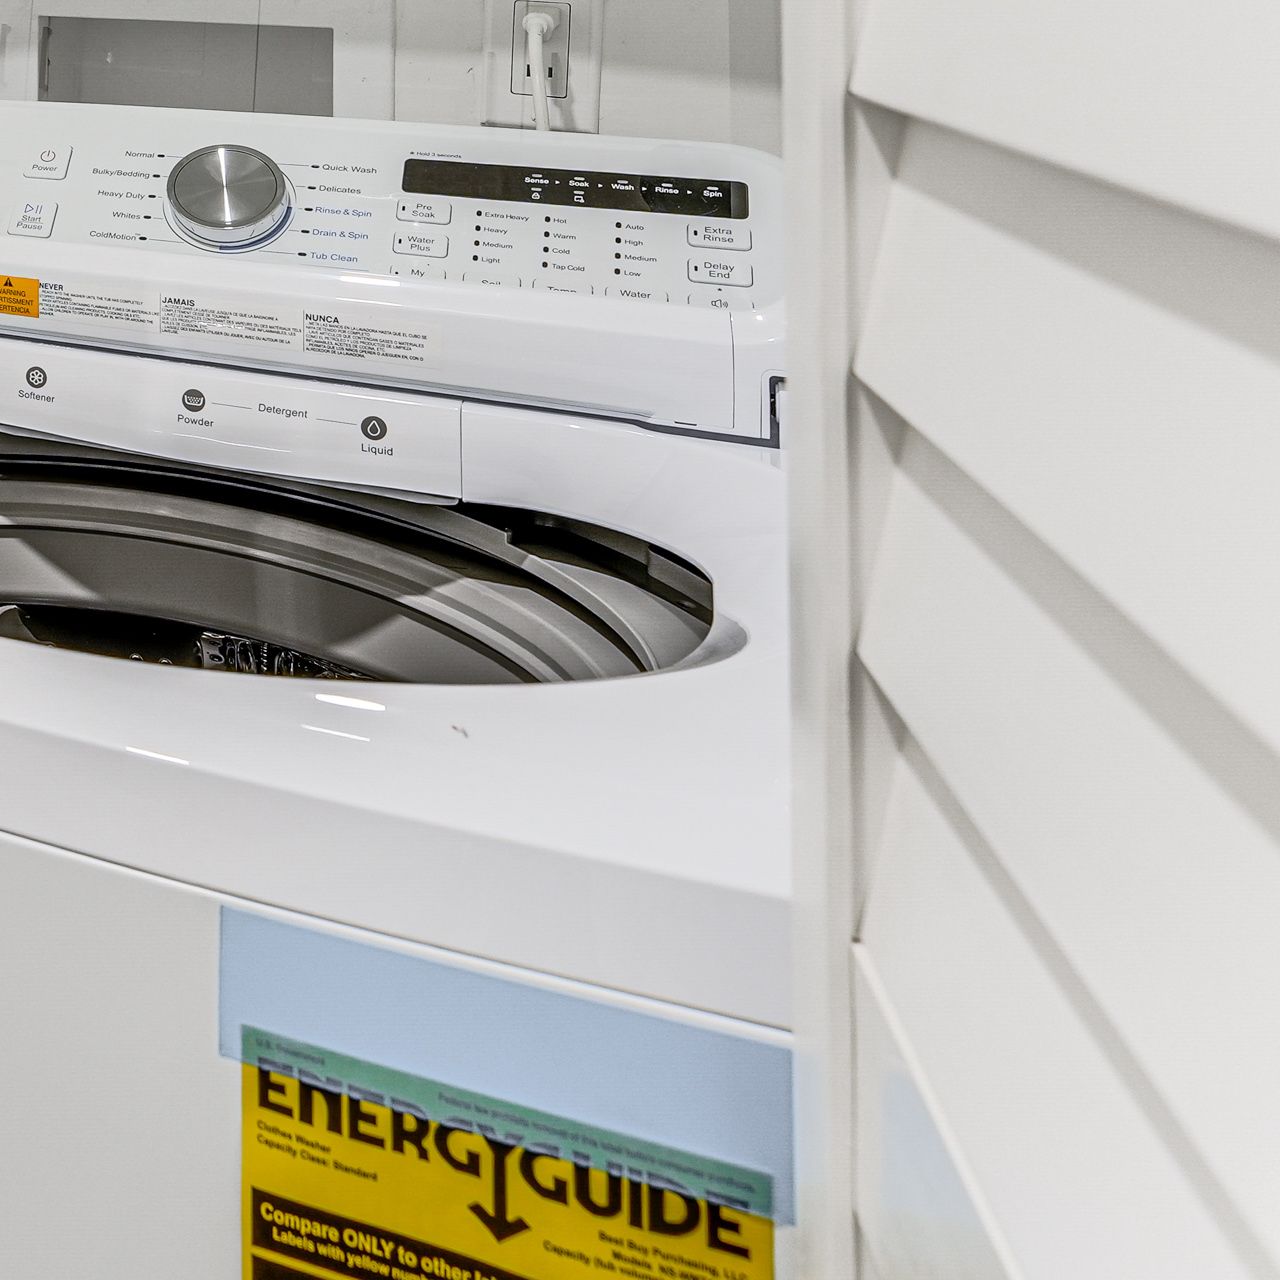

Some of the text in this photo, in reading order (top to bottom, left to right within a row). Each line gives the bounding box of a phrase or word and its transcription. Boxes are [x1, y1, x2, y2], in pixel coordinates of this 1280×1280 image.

[125, 150, 155, 158] Normal
[31, 164, 58, 172] Power
[322, 163, 378, 174] Quick Wash
[92, 167, 150, 179] Bulky/Bedding
[524, 177, 550, 185] Sense
[568, 180, 589, 188] Soak
[318, 185, 362, 194] Delicates
[611, 183, 635, 191] Wash
[654, 186, 680, 195] Rinse
[97, 190, 145, 200] Heavy Duty
[703, 189, 723, 198] Spin
[416, 203, 433, 211] Pre
[112, 211, 141, 219] Whites
[314, 206, 342, 215] Rinse
[351, 209, 373, 218] Spin
[411, 210, 436, 218] Soak
[484, 211, 530, 222] Extra Heavy
[21, 214, 42, 222] Start
[16, 222, 43, 231] Pause
[483, 226, 508, 234] Heavy
[625, 223, 645, 231] Auto
[704, 226, 733, 235] Extra
[311, 228, 337, 237] Drain
[347, 231, 369, 240] Spin
[552, 232, 577, 240] Warm
[703, 234, 735, 243] Rinse
[407, 235, 435, 244] Water
[410, 243, 431, 252] Plus
[482, 241, 513, 249] Medium
[551, 247, 570, 255] Cold
[310, 251, 358, 263] Tub Clean
[481, 256, 500, 264] Light
[624, 254, 657, 262] Medium
[552, 263, 585, 272] Tap Cold
[703, 261, 735, 272] Delay
[410, 268, 426, 277] My
[708, 271, 730, 279] End
[39, 282, 64, 291] NEVER
[619, 289, 652, 299] Water
[161, 297, 196, 307] JAMAIS
[305, 313, 340, 324] NUNCA
[17, 389, 56, 404] Softener
[257, 402, 308, 420] Detergent
[177, 413, 214, 428] Powder
[360, 443, 394, 457] Liquid
[256, 1120, 331, 1153] Clothes Washer
[256, 1133, 379, 1181] Capacity Class: Standard
[257, 1055, 752, 1261] ENERGYGUIDE
[260, 1201, 340, 1243] Compare
[342, 1228, 395, 1261] ONLY
[397, 1245, 418, 1269] to
[420, 1256, 472, 1280] other
[272, 1225, 316, 1253] Labels
[316, 1241, 346, 1263] with
[346, 1251, 390, 1277] yellow
[542, 1239, 591, 1266] Capacity
[598, 1229, 625, 1247] Best
[626, 1238, 649, 1256] Buy
[652, 1246, 719, 1278] Purchasing,
